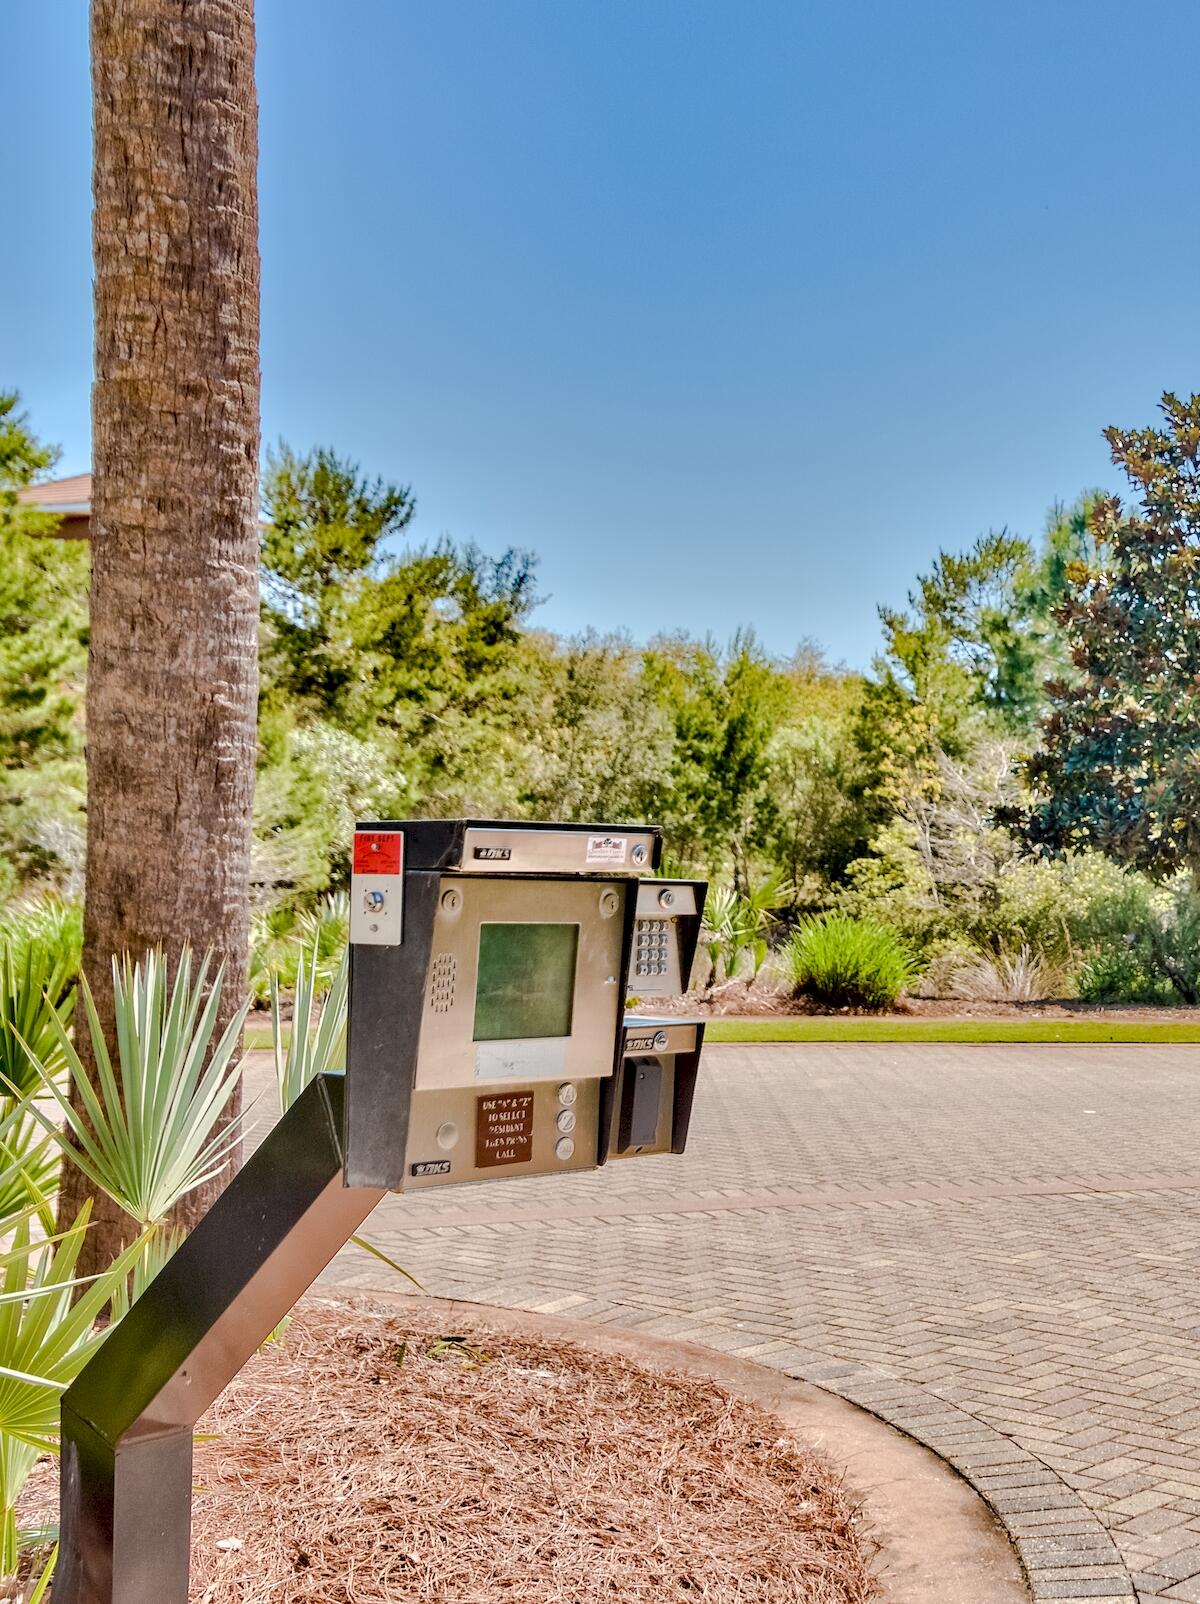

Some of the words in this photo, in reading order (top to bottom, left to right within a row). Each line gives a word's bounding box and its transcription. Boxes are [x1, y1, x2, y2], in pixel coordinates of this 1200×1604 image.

[483, 1101, 496, 1110] USE
[511, 1099, 517, 1107] &
[488, 1113, 498, 1122] TO
[499, 1110, 526, 1120] SELECT
[496, 1149, 516, 1159] CALL
